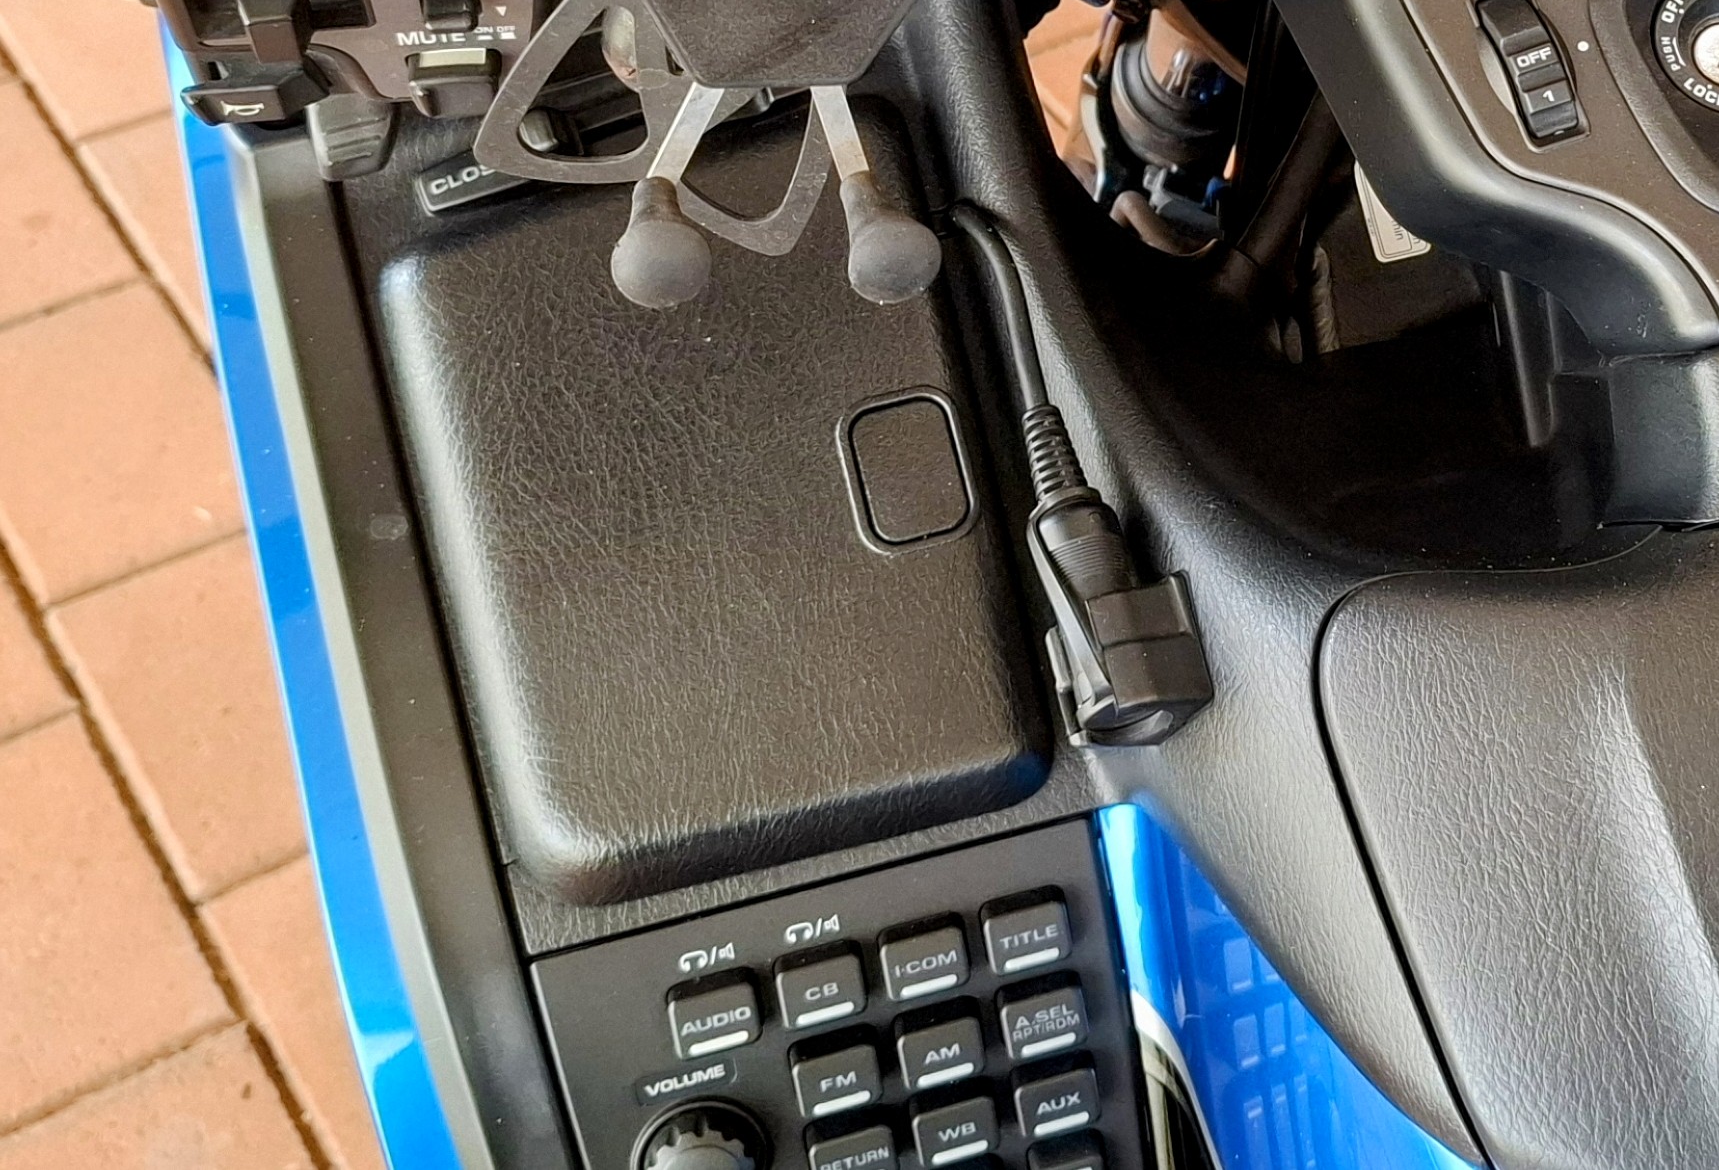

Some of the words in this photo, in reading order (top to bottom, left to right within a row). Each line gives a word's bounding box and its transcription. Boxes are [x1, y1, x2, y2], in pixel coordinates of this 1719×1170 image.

[1516, 47, 1552, 68] OFF
[1661, 37, 1681, 72] PUSH
[1542, 90, 1555, 102] 1
[999, 923, 1059, 949] TITLE
[804, 981, 839, 1001] CB
[681, 1004, 752, 1036] AUDIO
[1015, 1003, 1074, 1029] A.SEL
[923, 1041, 961, 1065] AM
[643, 1062, 726, 1097] VOLUME
[818, 1069, 857, 1093] FM
[1035, 1090, 1082, 1115] AUX
[938, 1122, 977, 1142] WB
